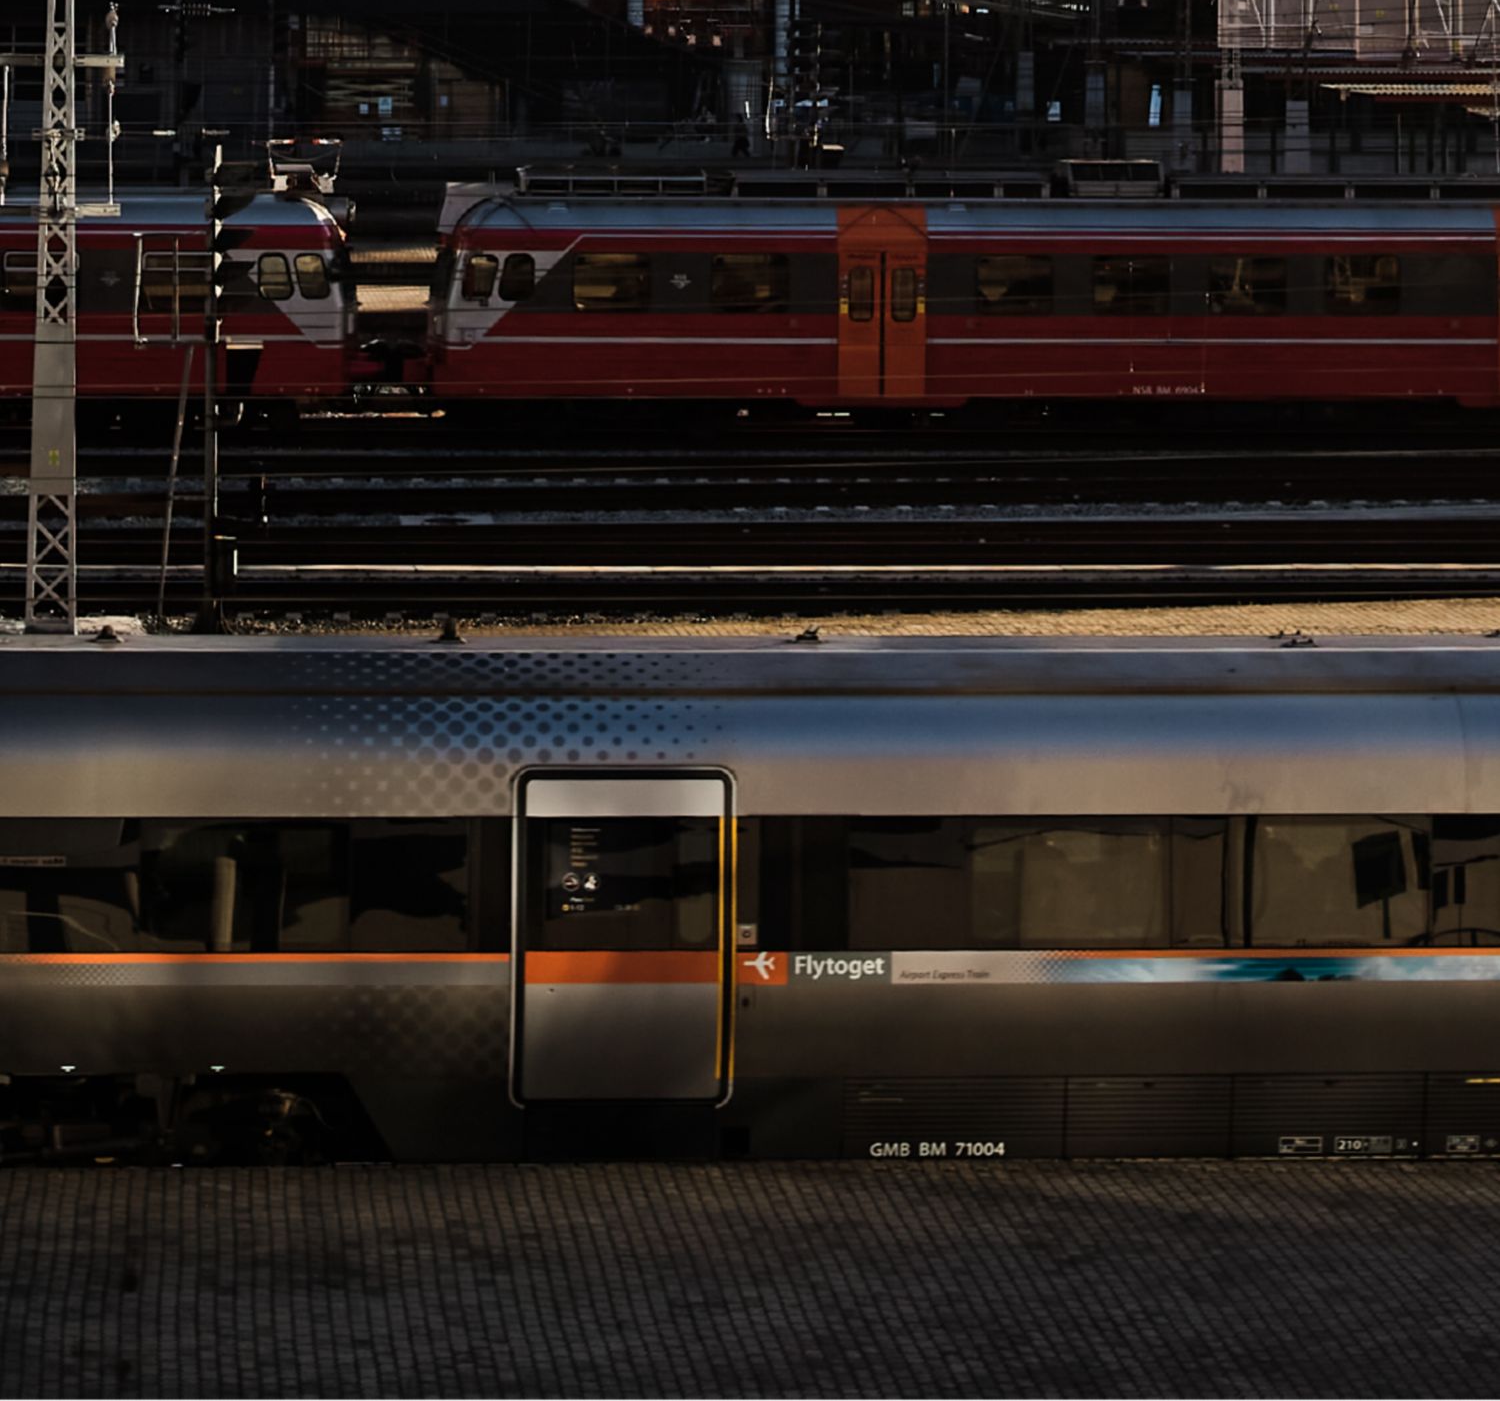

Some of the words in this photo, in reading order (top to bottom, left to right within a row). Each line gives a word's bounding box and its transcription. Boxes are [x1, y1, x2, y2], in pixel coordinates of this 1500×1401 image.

[795, 954, 886, 980] Flytoget
[899, 970, 931, 981] Airport
[932, 970, 965, 981] Express
[967, 970, 990, 980] Train
[869, 1141, 911, 1157] GMB
[918, 1141, 948, 1157] BM
[954, 1141, 1006, 1157] 71004
[1338, 1140, 1362, 1150] 210
